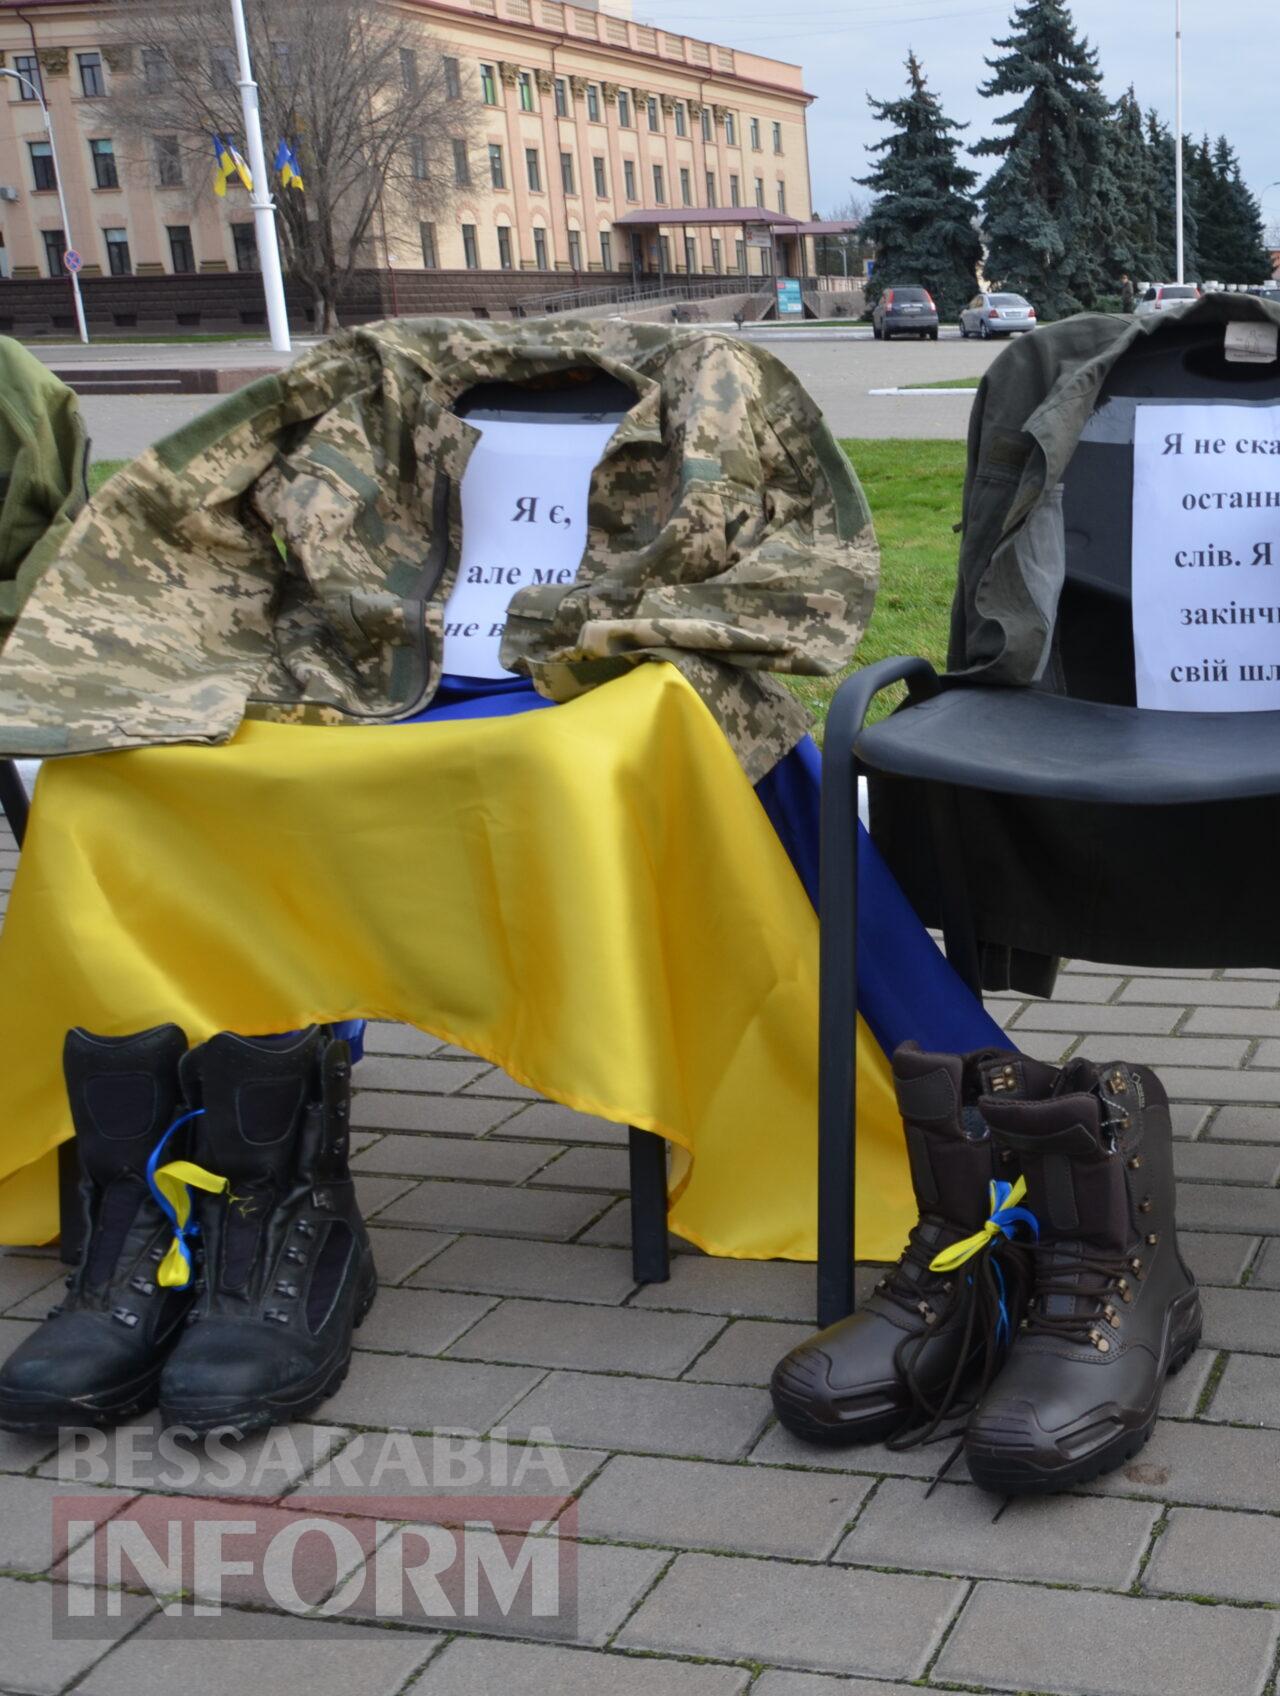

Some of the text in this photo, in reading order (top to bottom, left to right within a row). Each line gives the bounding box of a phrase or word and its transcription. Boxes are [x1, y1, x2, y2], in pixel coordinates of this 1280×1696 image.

[1161, 433, 1184, 455] Я
[1194, 439, 1227, 455] не
[510, 496, 572, 529] Я є,
[1174, 543, 1242, 568] слів.
[1250, 542, 1274, 566] Я
[467, 565, 578, 585] але ме
[444, 622, 480, 637] не
[1169, 658, 1230, 684] свій
